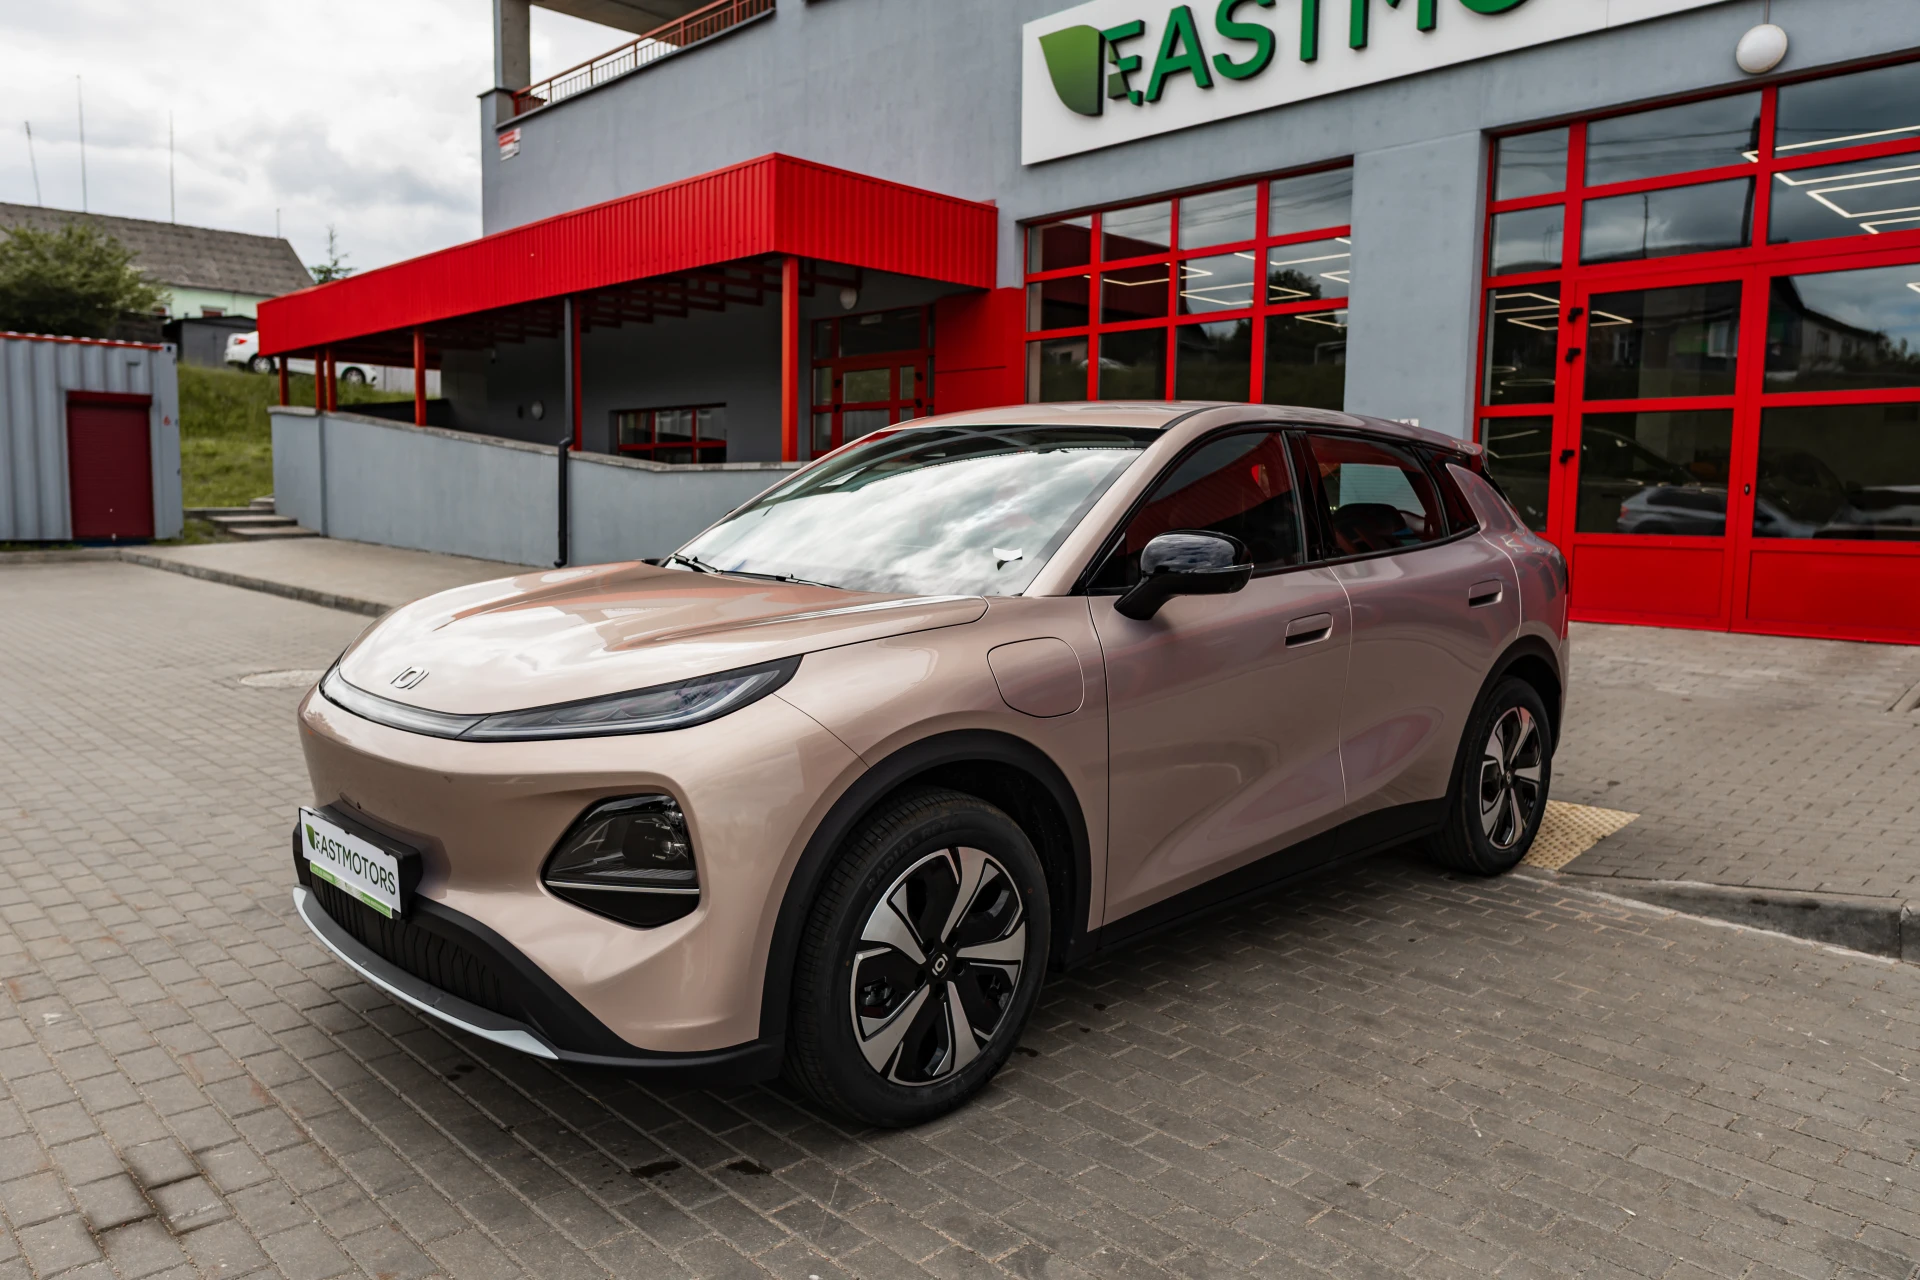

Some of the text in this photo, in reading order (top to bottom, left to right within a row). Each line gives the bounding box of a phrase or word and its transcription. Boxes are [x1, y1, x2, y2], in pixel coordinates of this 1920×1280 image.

[1102, 0, 1528, 106] EAST
[314, 830, 396, 895] EASTMOTORS
[866, 836, 918, 891] RADIAL
